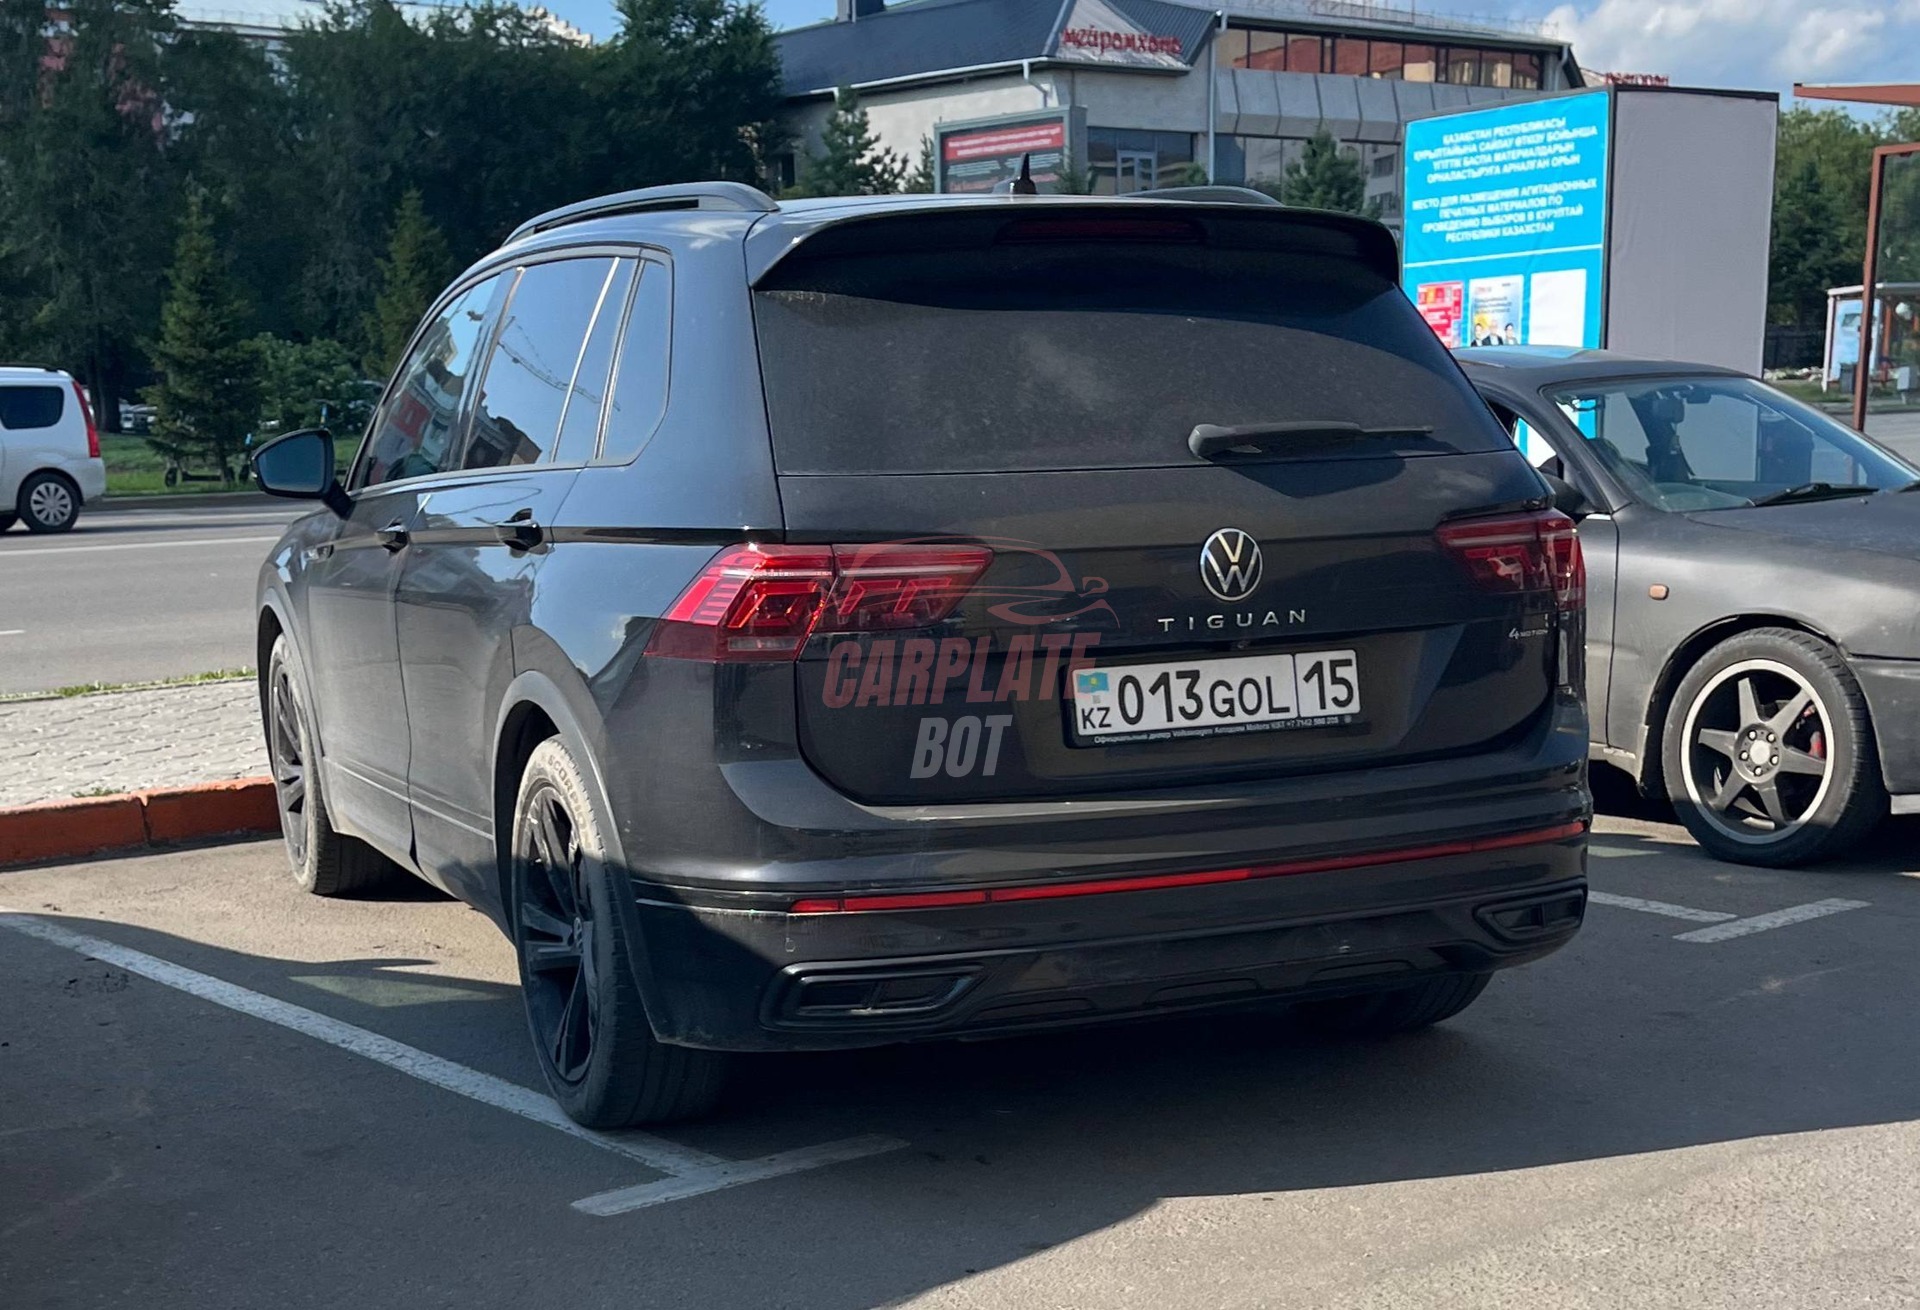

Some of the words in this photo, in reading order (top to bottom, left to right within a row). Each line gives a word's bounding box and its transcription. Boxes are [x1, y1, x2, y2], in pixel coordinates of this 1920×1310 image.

[1157, 609, 1306, 632] TIGUAN
[1081, 706, 1112, 730] KZ
[1302, 658, 1354, 710] 15
